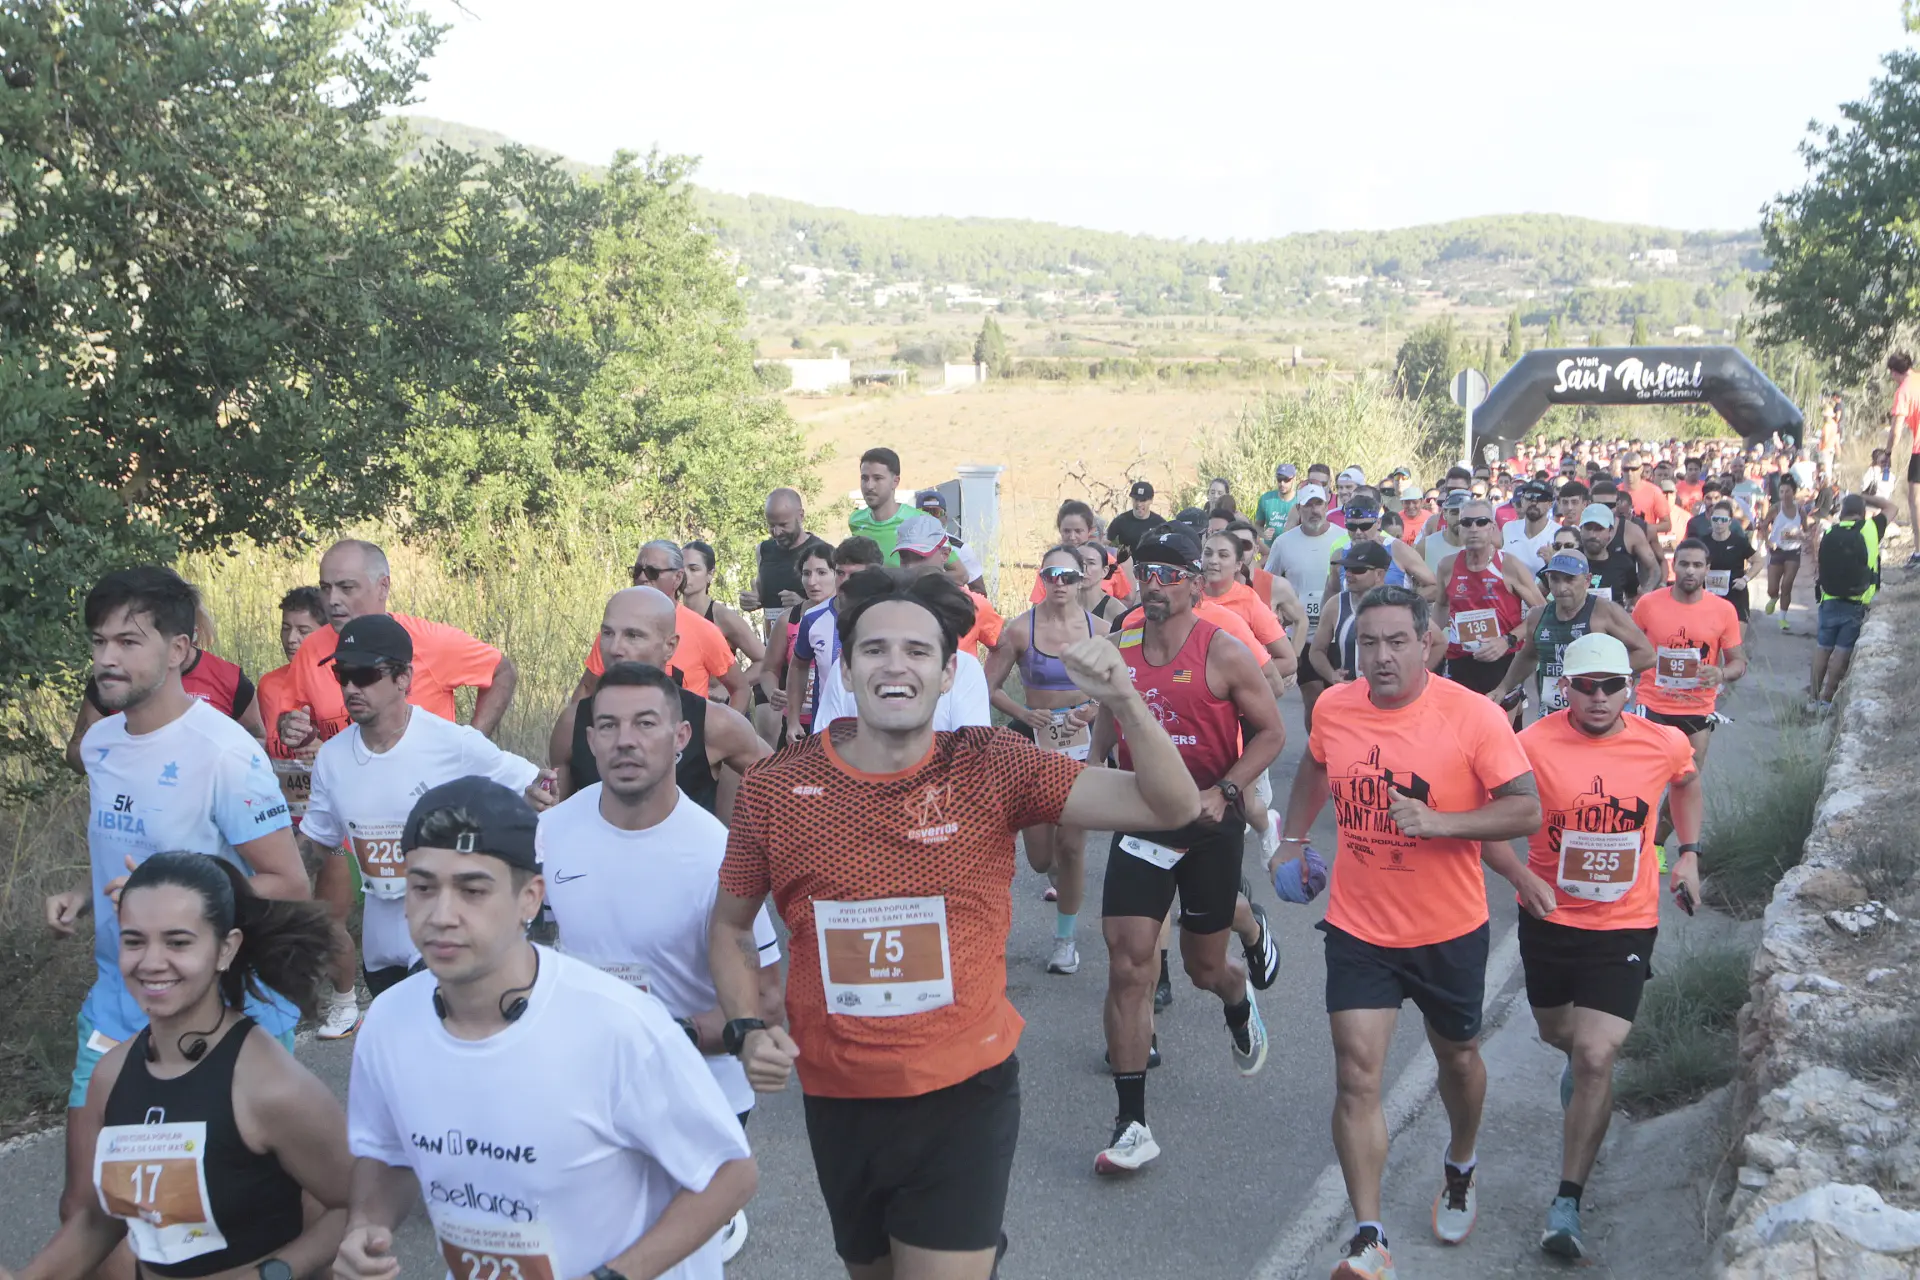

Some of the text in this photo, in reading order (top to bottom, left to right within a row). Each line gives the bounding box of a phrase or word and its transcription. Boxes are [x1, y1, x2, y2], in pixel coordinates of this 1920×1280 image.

[1576, 356, 1599, 367] Visit
[1554, 357, 1704, 393] Sant Antoni
[1636, 389, 1702, 398] de Portmany
[1467, 620, 1488, 634] 136
[1670, 659, 1685, 671] 95
[1171, 734, 1197, 745] ERS
[286, 774, 311, 791] 449
[1350, 776, 1375, 806] 10
[113, 794, 134, 813] 5k
[266, 804, 287, 818] IBIZ
[1333, 795, 1371, 831] SANT
[98, 810, 146, 836] IBIZA
[1343, 831, 1369, 844] CURSA
[1371, 838, 1418, 849] POPULAR
[366, 840, 405, 863] 226
[1582, 851, 1620, 871] 255
[851, 916, 867, 924] PLA
[882, 913, 903, 922] SANT
[905, 911, 934, 920] MATEU
[857, 906, 882, 915] CURSA
[884, 904, 920, 912] POPULAR
[863, 930, 904, 963] 75
[465, 1137, 537, 1164] PHONE
[131, 1164, 164, 1204] 17
[461, 1251, 525, 1280] 223
